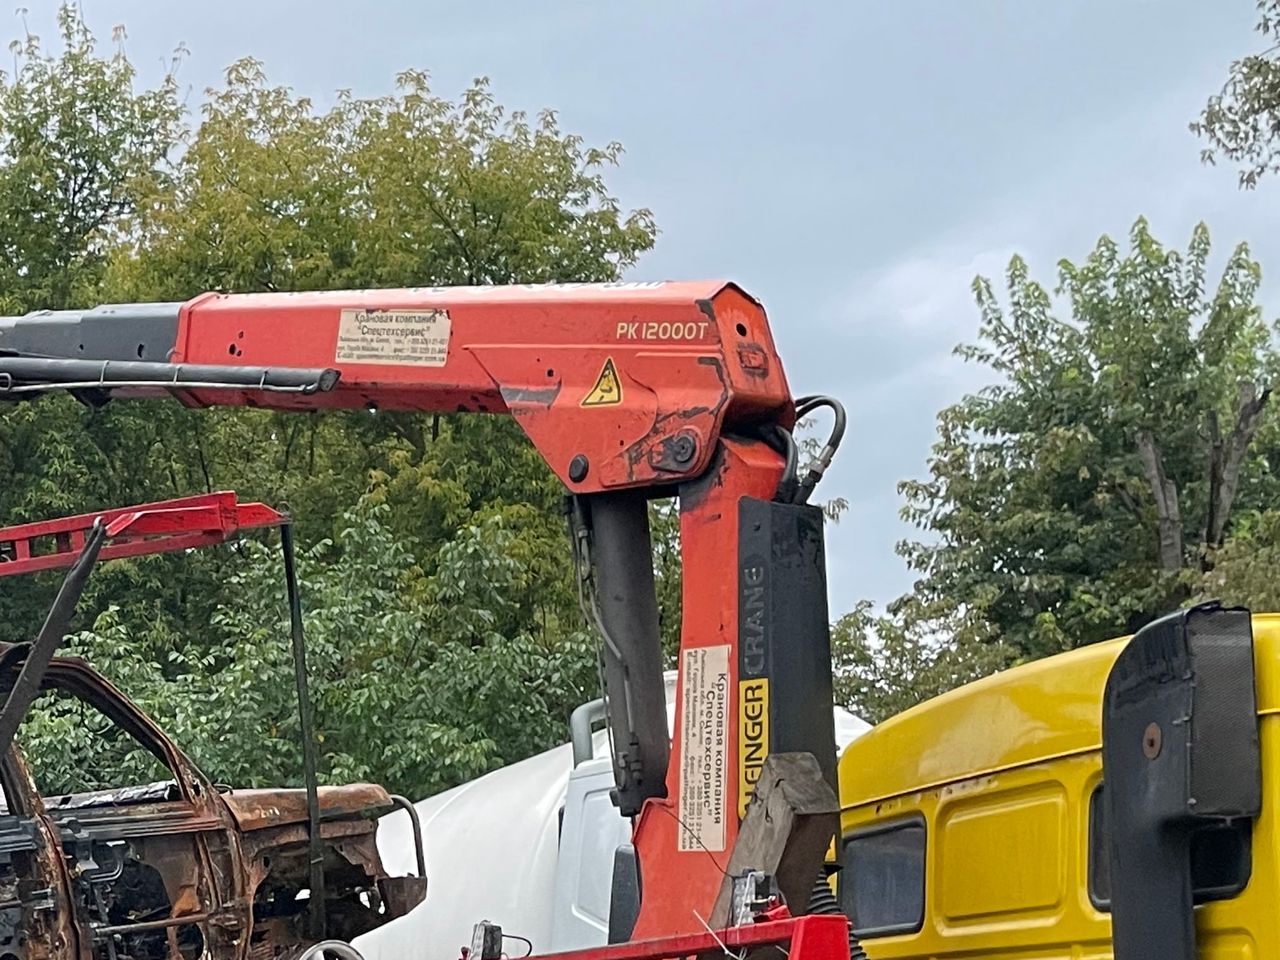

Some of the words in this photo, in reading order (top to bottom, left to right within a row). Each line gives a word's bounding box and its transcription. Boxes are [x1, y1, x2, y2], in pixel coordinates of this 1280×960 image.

[354, 313, 393, 324] Крановая
[616, 322, 638, 340] PK
[641, 322, 709, 340] 12000T
[744, 567, 765, 675] CRANE
[715, 673, 727, 746] Крановая
[744, 684, 764, 811] FINGER
[714, 750, 723, 824] компания
